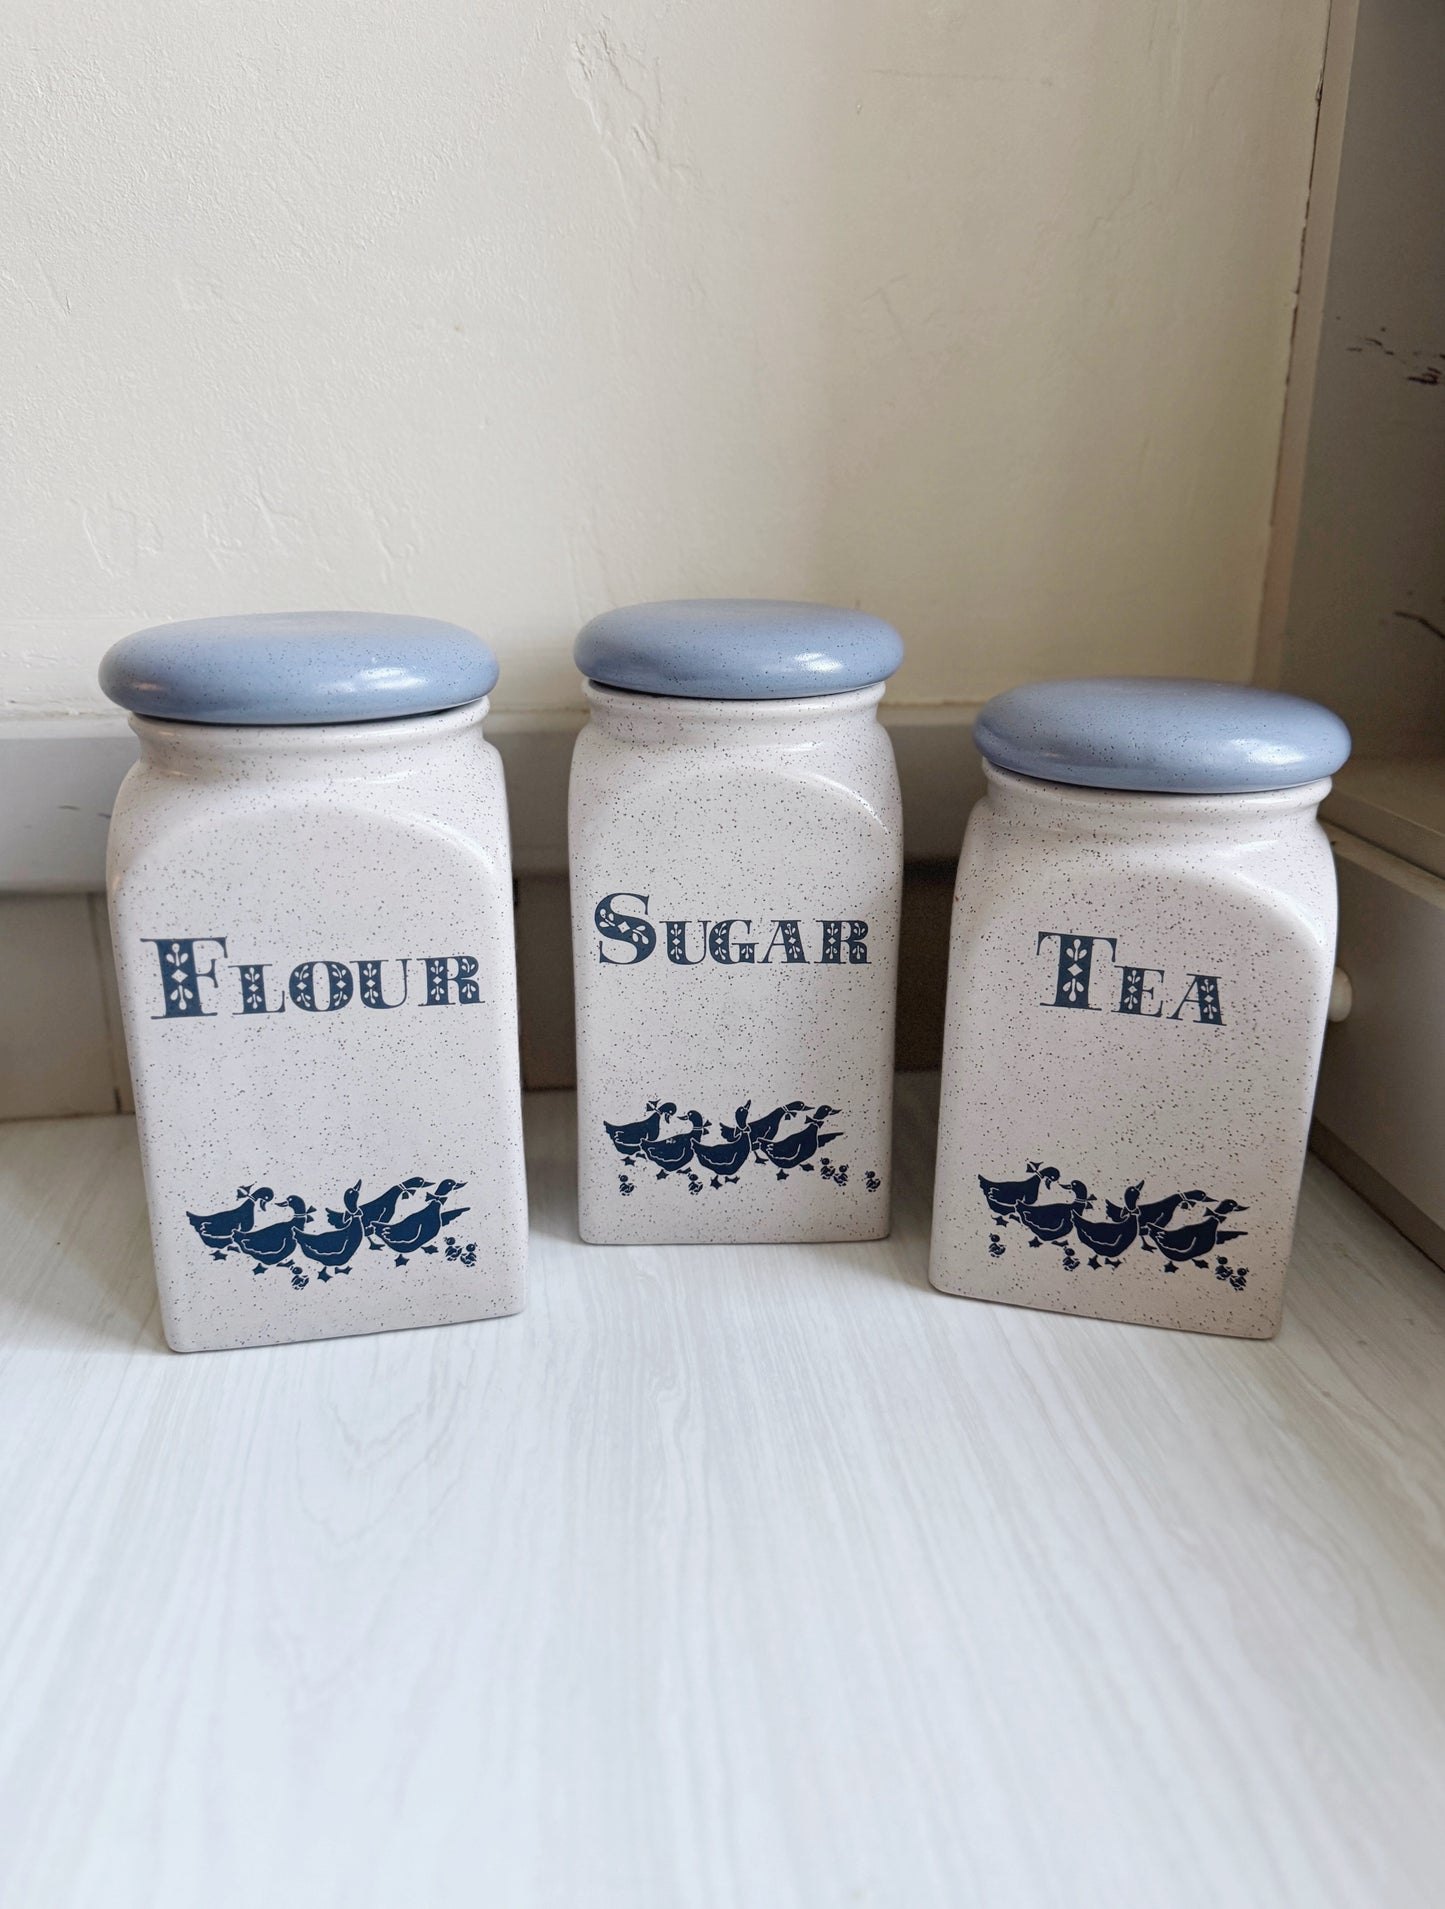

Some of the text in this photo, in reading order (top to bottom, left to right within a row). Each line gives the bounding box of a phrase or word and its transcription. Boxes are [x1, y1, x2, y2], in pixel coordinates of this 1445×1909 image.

[594, 892, 872, 965] SUGAR
[140, 936, 485, 1020] FLOUR
[1036, 931, 1227, 1026] TEA
